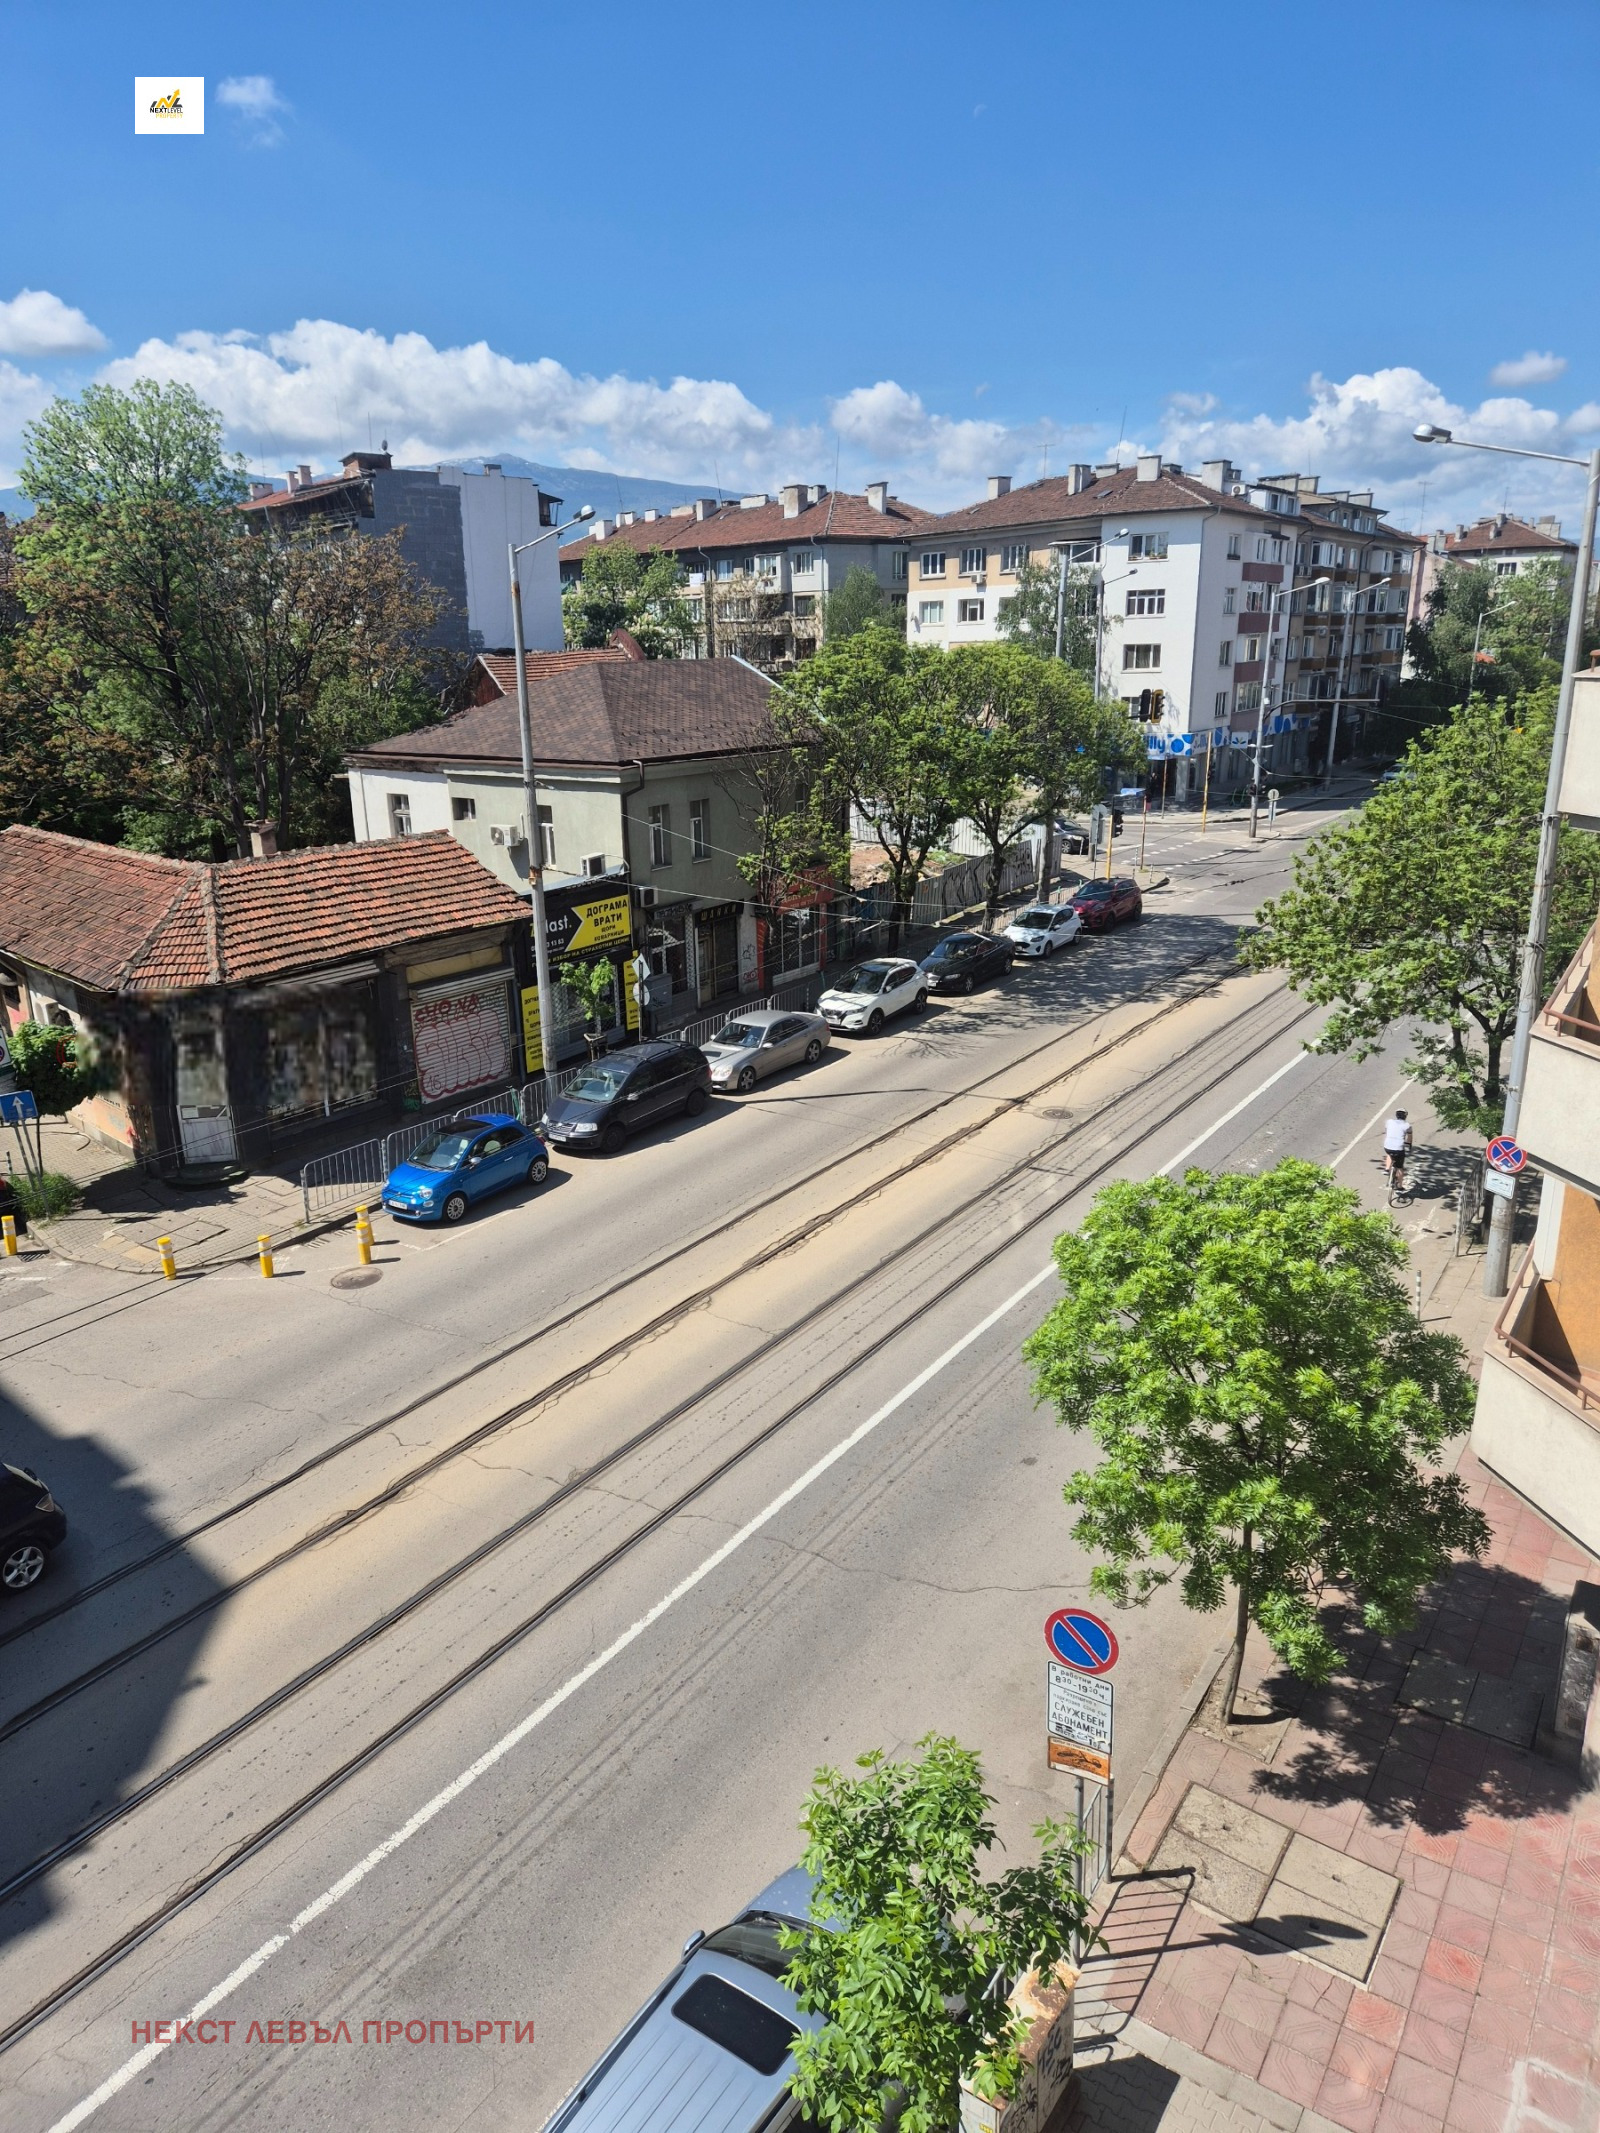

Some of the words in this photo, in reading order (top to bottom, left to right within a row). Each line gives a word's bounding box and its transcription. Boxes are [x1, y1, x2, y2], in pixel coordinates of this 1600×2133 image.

[587, 899, 628, 918] ДОГРАМА
[594, 912, 622, 927] ВРАТИ
[1052, 1711, 1107, 1739] АБОНАМЕНТ
[1054, 1701, 1104, 1727] СЛУЖЕБЕН
